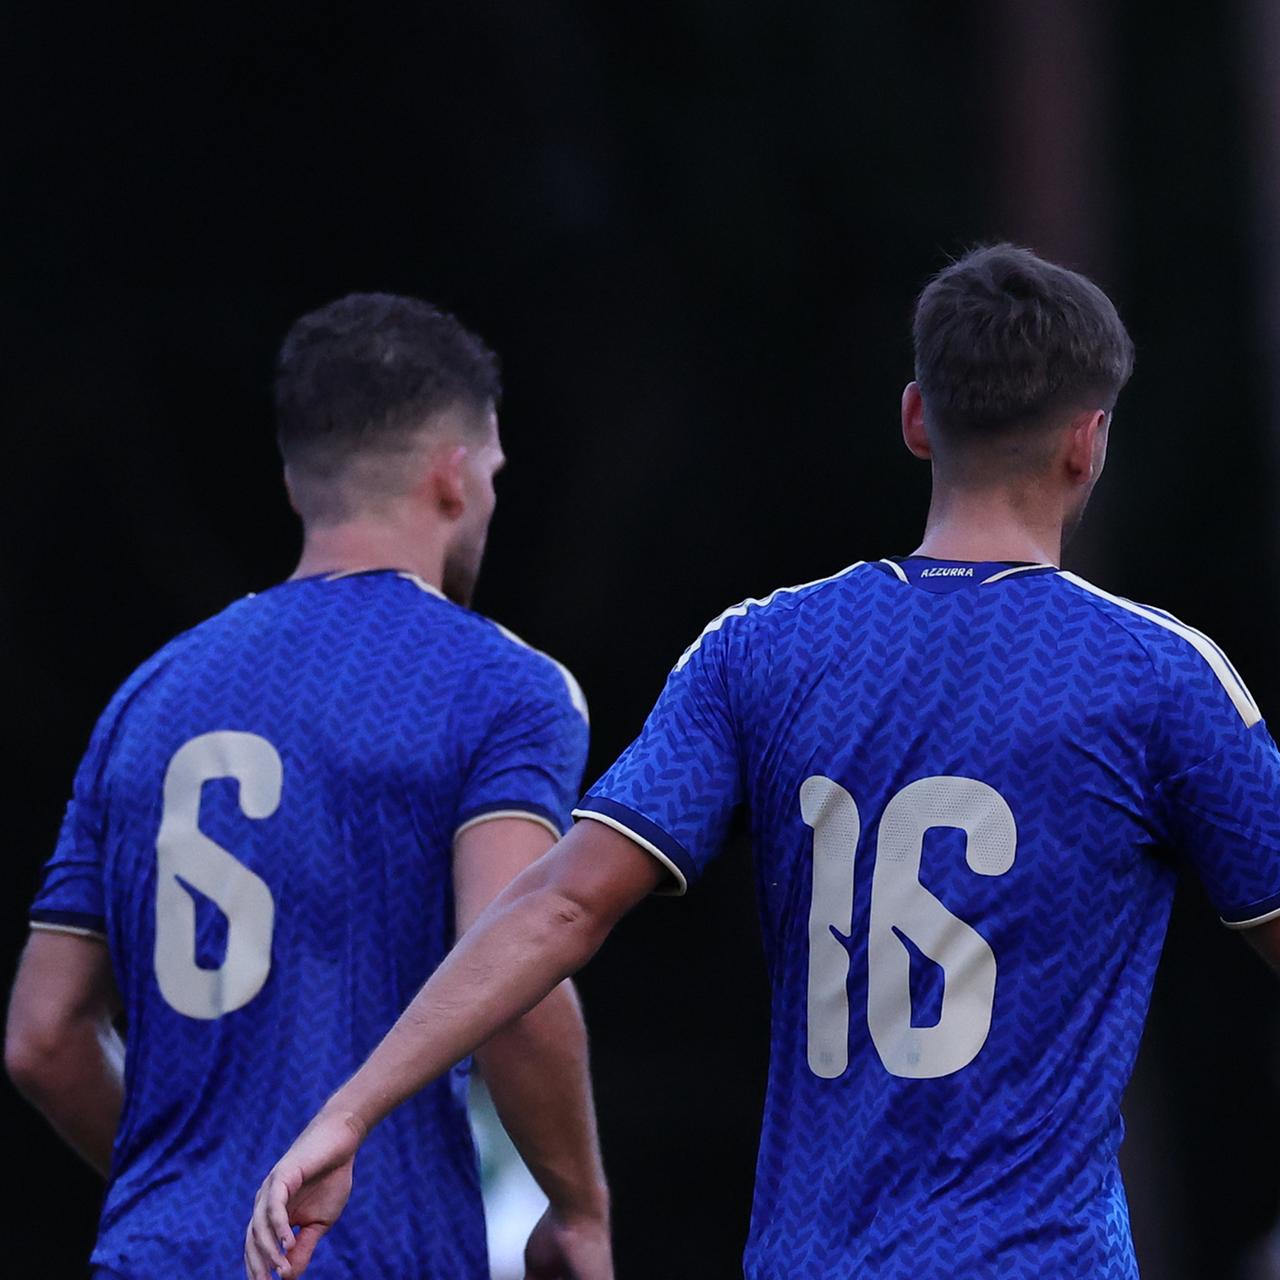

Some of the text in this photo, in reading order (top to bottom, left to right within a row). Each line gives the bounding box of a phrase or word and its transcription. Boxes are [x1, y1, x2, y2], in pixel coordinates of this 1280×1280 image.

[920, 567, 974, 578] AZZURRA
[154, 730, 283, 1019] 6
[799, 775, 1017, 1079] 16
